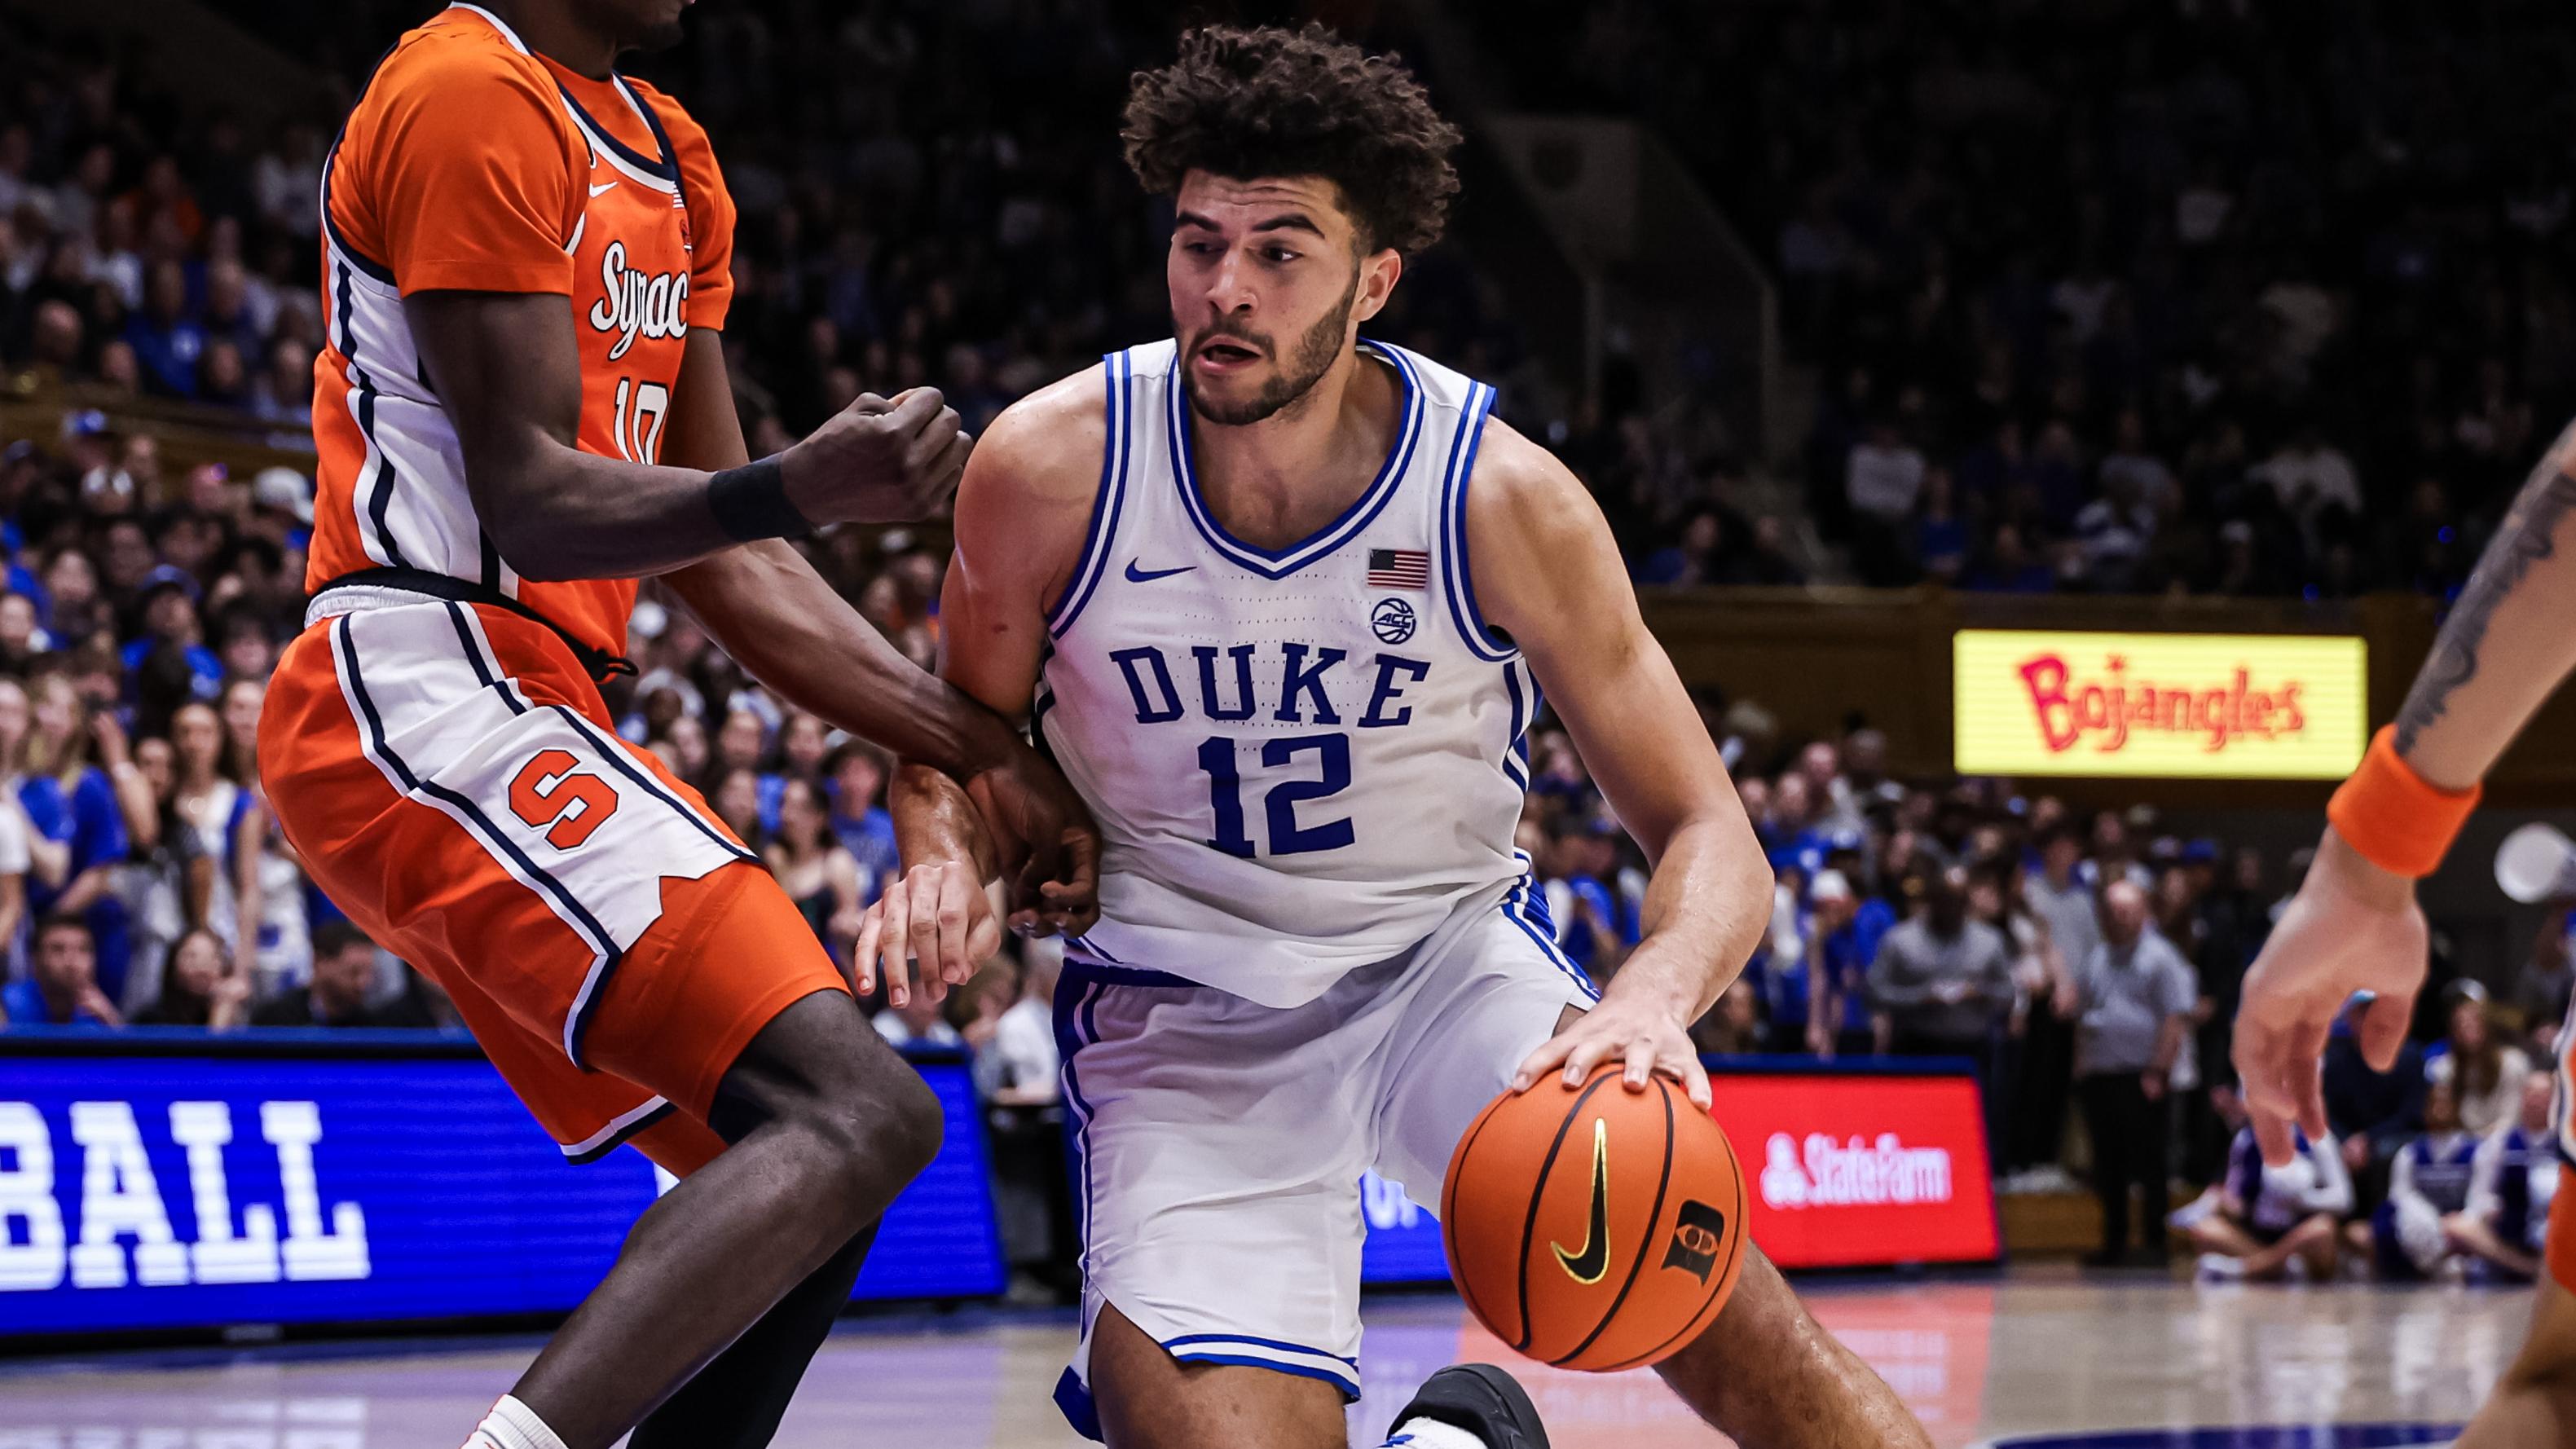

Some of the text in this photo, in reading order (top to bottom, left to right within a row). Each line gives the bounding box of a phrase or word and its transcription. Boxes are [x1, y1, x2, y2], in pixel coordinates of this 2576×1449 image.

[1109, 642, 1431, 728] DUKE
[2018, 654, 2303, 751] Bojangles
[508, 749, 619, 851] S
[1198, 732, 1355, 859] 12
[0, 1100, 372, 1292] BALL
